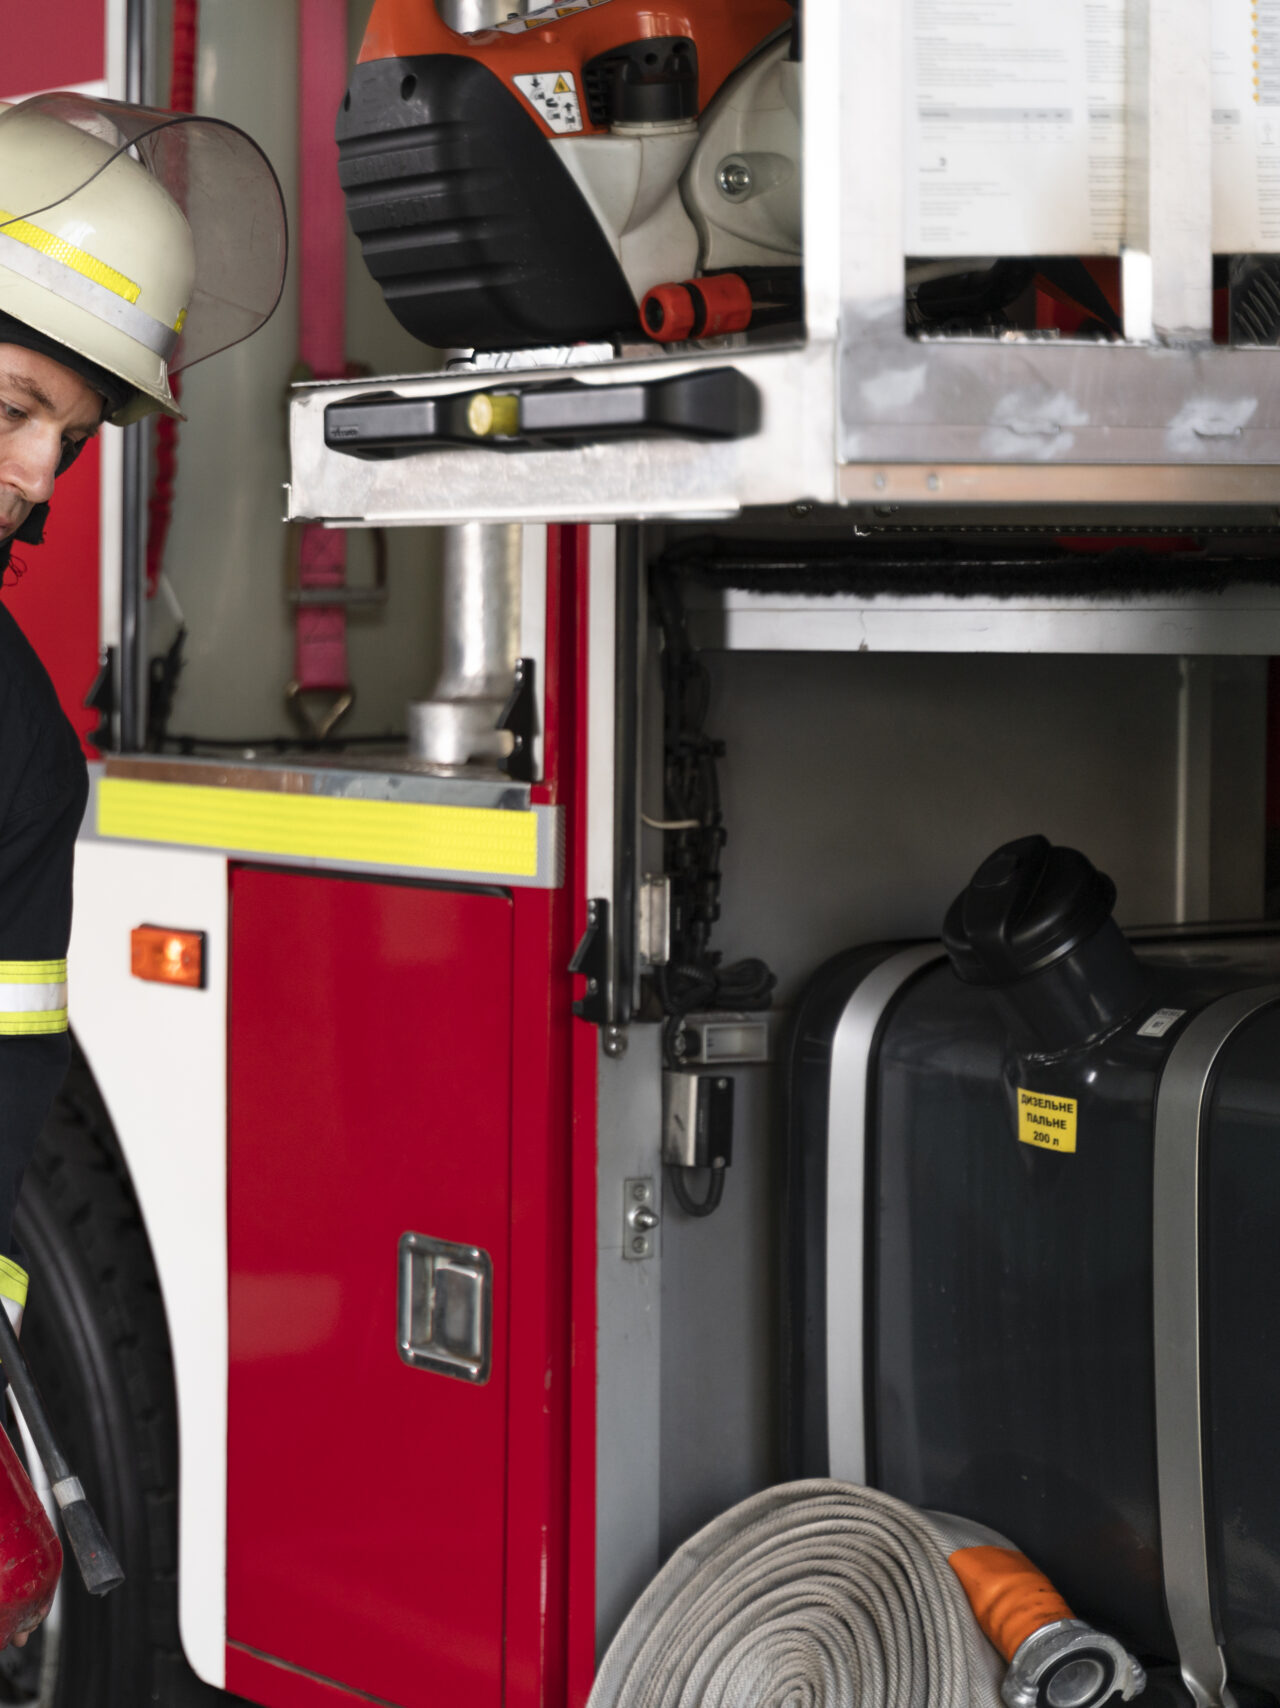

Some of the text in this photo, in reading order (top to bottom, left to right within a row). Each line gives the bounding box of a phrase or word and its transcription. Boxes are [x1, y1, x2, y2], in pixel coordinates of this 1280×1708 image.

[1021, 1094, 1074, 1114] ДИЗЕЛЬНЕ
[1026, 1112, 1067, 1130] ПАЛЬНЕ
[1033, 1130, 1050, 1144] 200
